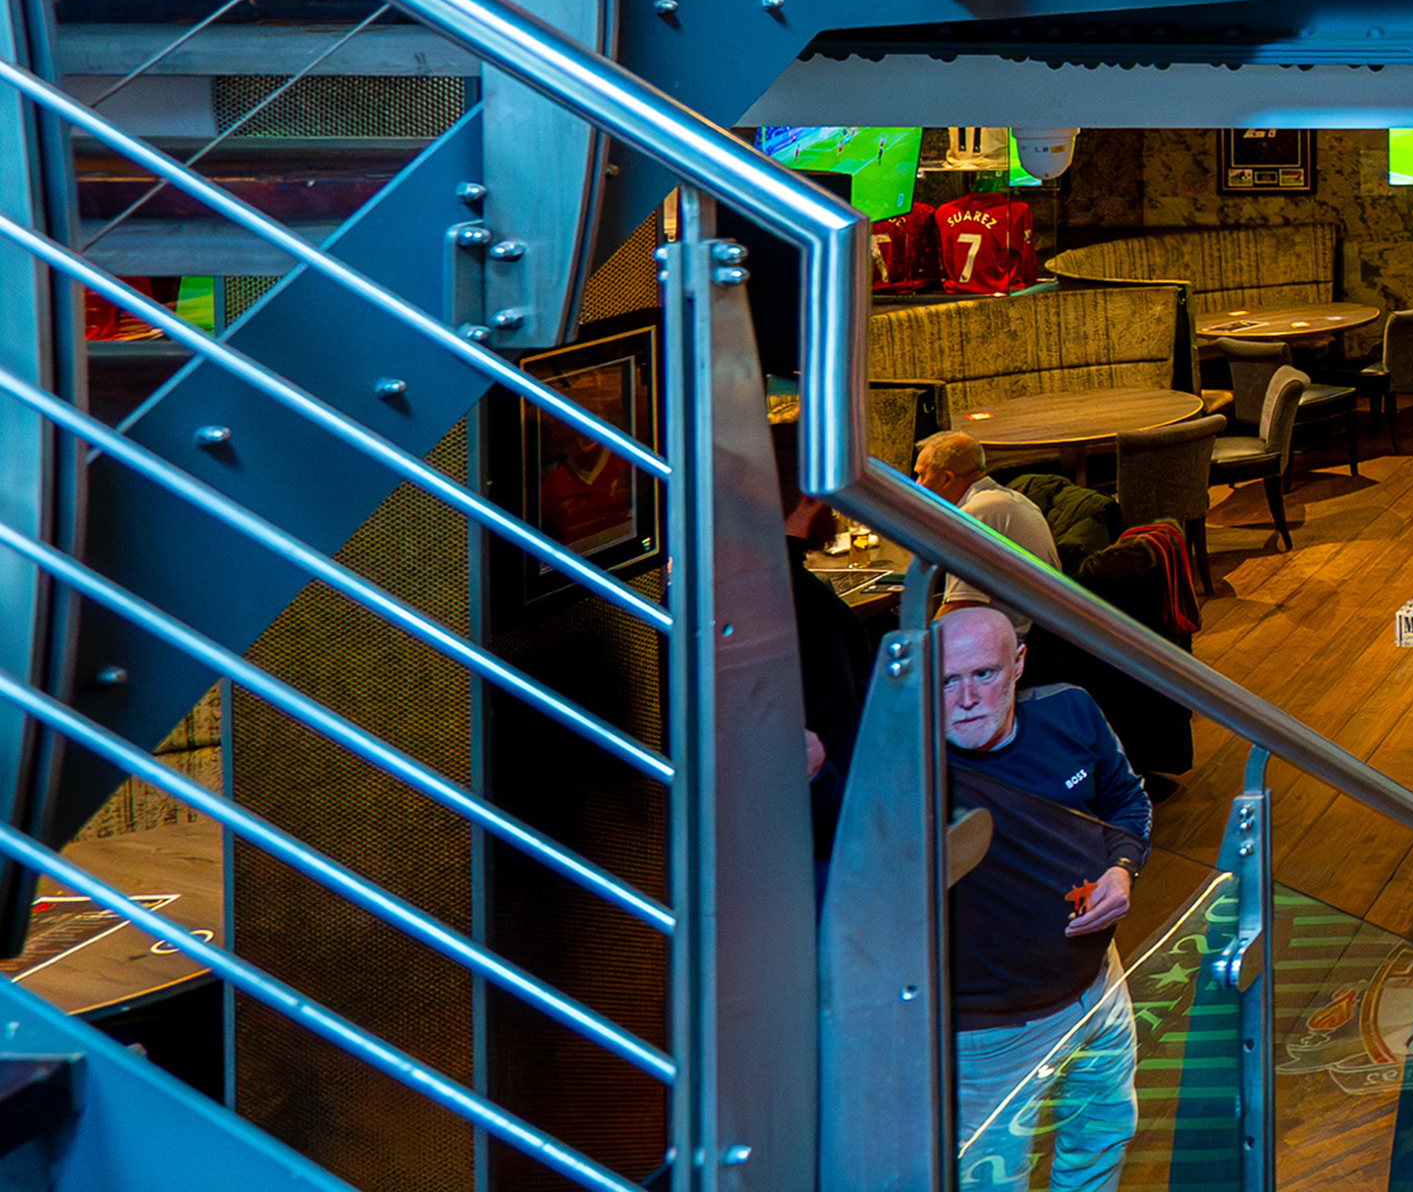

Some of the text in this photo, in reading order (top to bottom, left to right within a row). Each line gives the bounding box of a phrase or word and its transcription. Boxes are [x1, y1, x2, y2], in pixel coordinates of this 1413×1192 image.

[947, 210, 998, 230] SUAREZ
[957, 233, 982, 284] 7
[1064, 768, 1088, 790] BOSS
